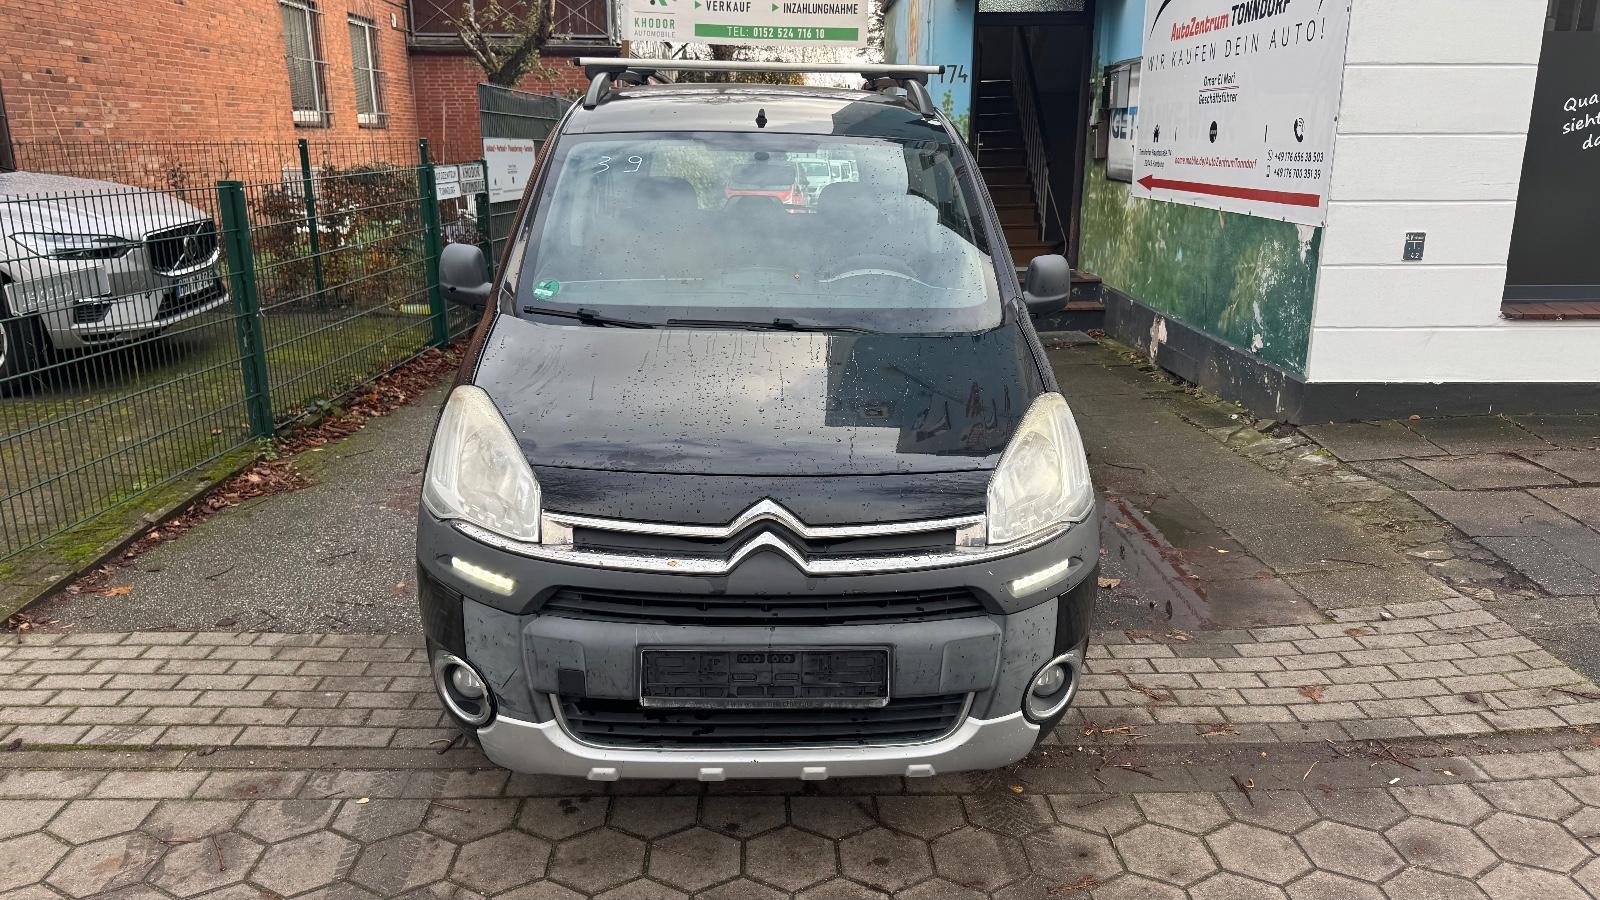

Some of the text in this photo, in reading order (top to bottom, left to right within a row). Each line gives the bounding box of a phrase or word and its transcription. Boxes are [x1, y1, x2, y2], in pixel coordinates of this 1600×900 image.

[706, 0, 752, 13] VERKAUF
[783, 3, 859, 15] INZAHLUNGNAHME
[634, 17, 675, 29] KHODOR
[1170, 0, 1292, 42] AutoZentrum TONNDORF
[634, 29, 677, 39] AUTOMOBILE
[727, 26, 825, 39] TEL: 0152 524 716 10
[1147, 17, 1326, 72] WIR KAUFEN DEIN AUTO!
[1198, 91, 1239, 105] Geschäftsführer
[1562, 111, 1600, 135] sieht
